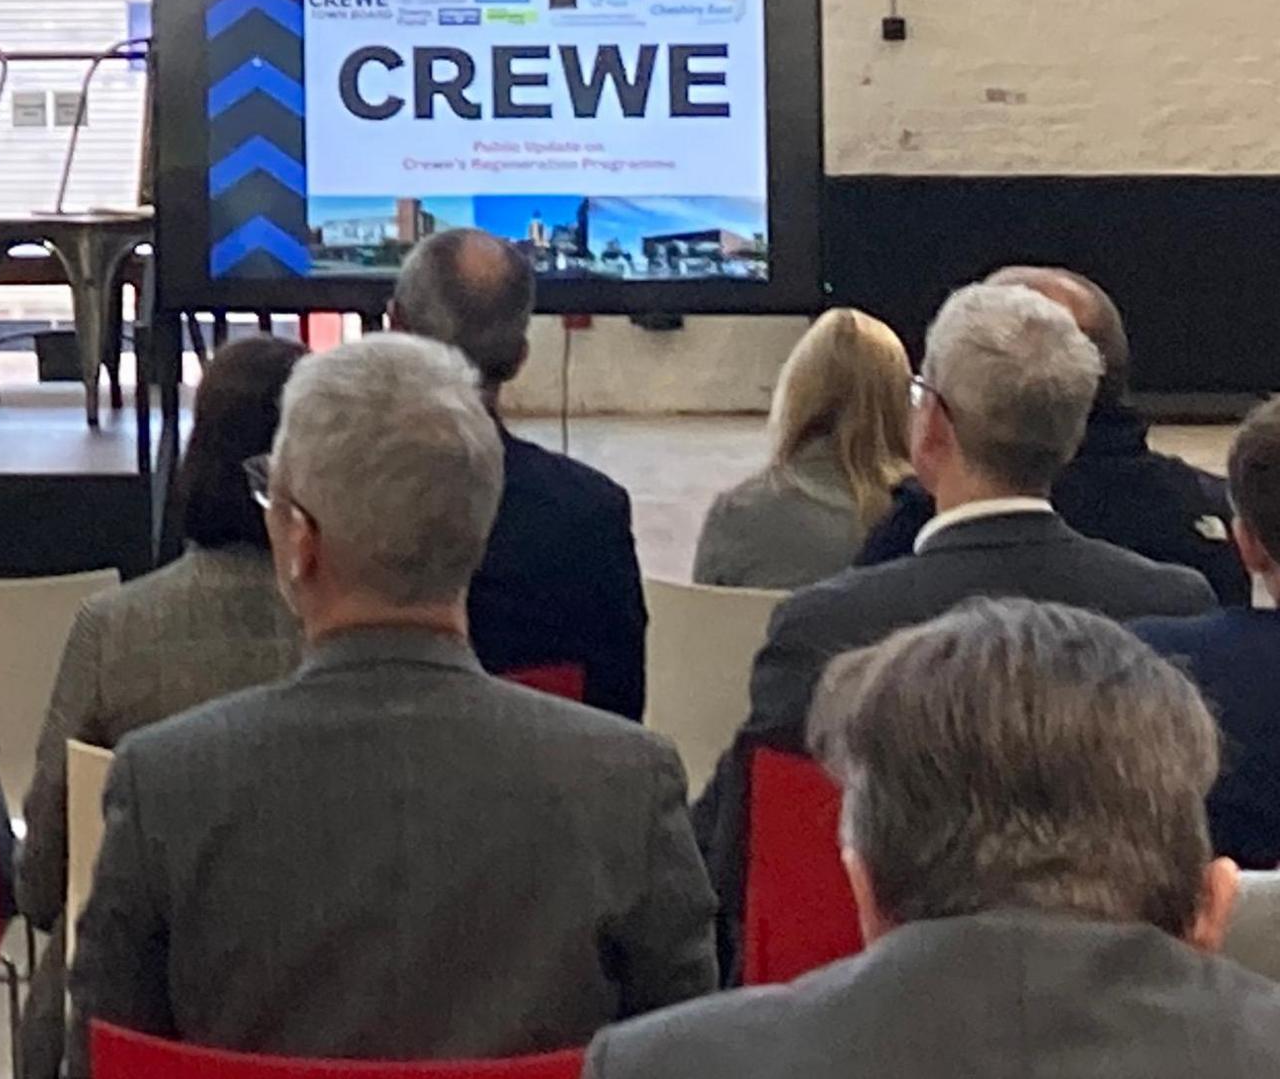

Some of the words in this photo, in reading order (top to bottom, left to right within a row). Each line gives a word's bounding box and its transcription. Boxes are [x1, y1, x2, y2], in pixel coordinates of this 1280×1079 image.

[338, 43, 731, 120] CREWE
[473, 141, 520, 153] Public
[524, 141, 581, 154] Update
[584, 142, 604, 152] on
[402, 158, 466, 170] Crewe's
[470, 158, 578, 172] Regeneration
[582, 158, 676, 172] Programme
